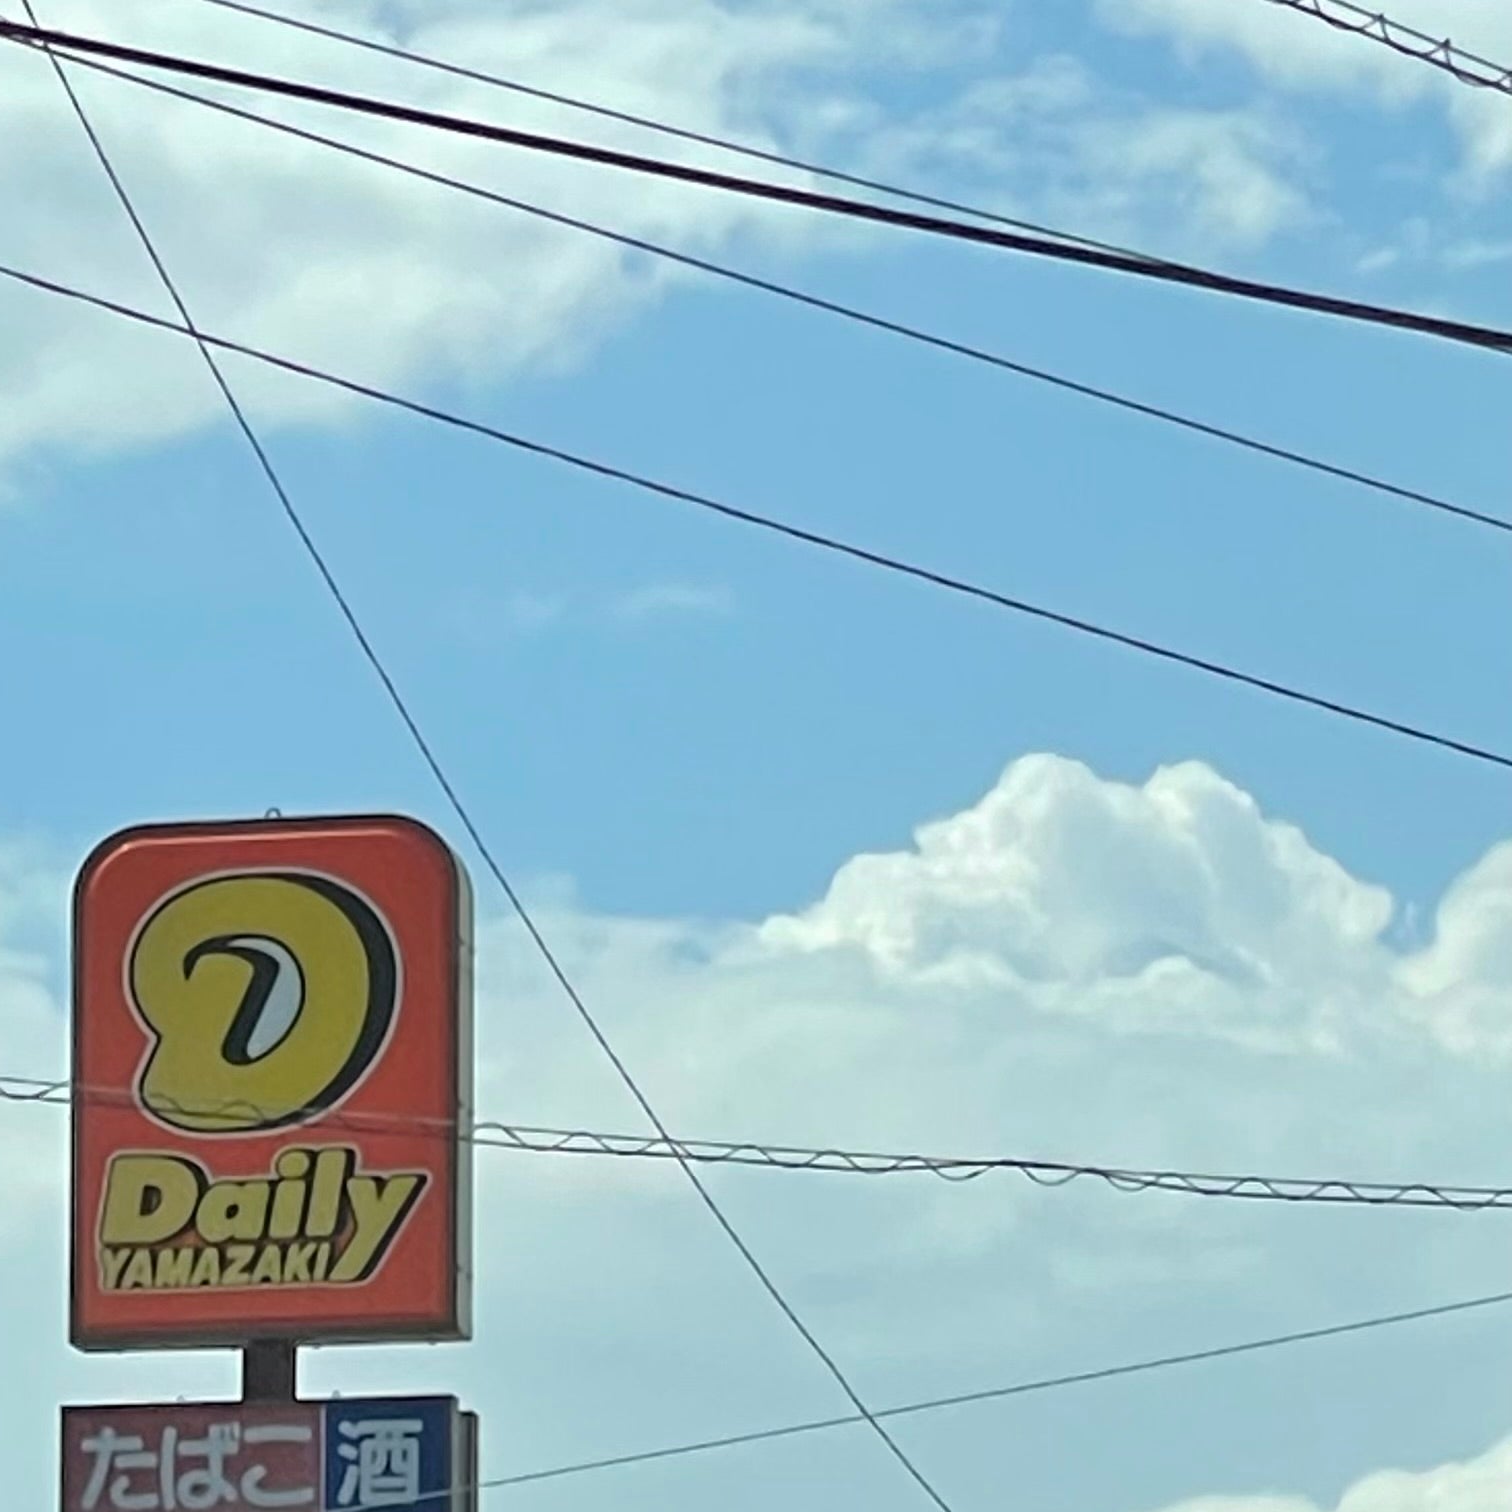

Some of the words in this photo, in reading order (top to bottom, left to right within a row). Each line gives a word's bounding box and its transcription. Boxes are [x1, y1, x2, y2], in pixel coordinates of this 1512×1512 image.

[97, 1145, 427, 1285] Daily
[101, 1240, 333, 1292] YAMAZAKI
[80, 1418, 313, 1512] たばこ
[335, 1416, 425, 1508] 酒
